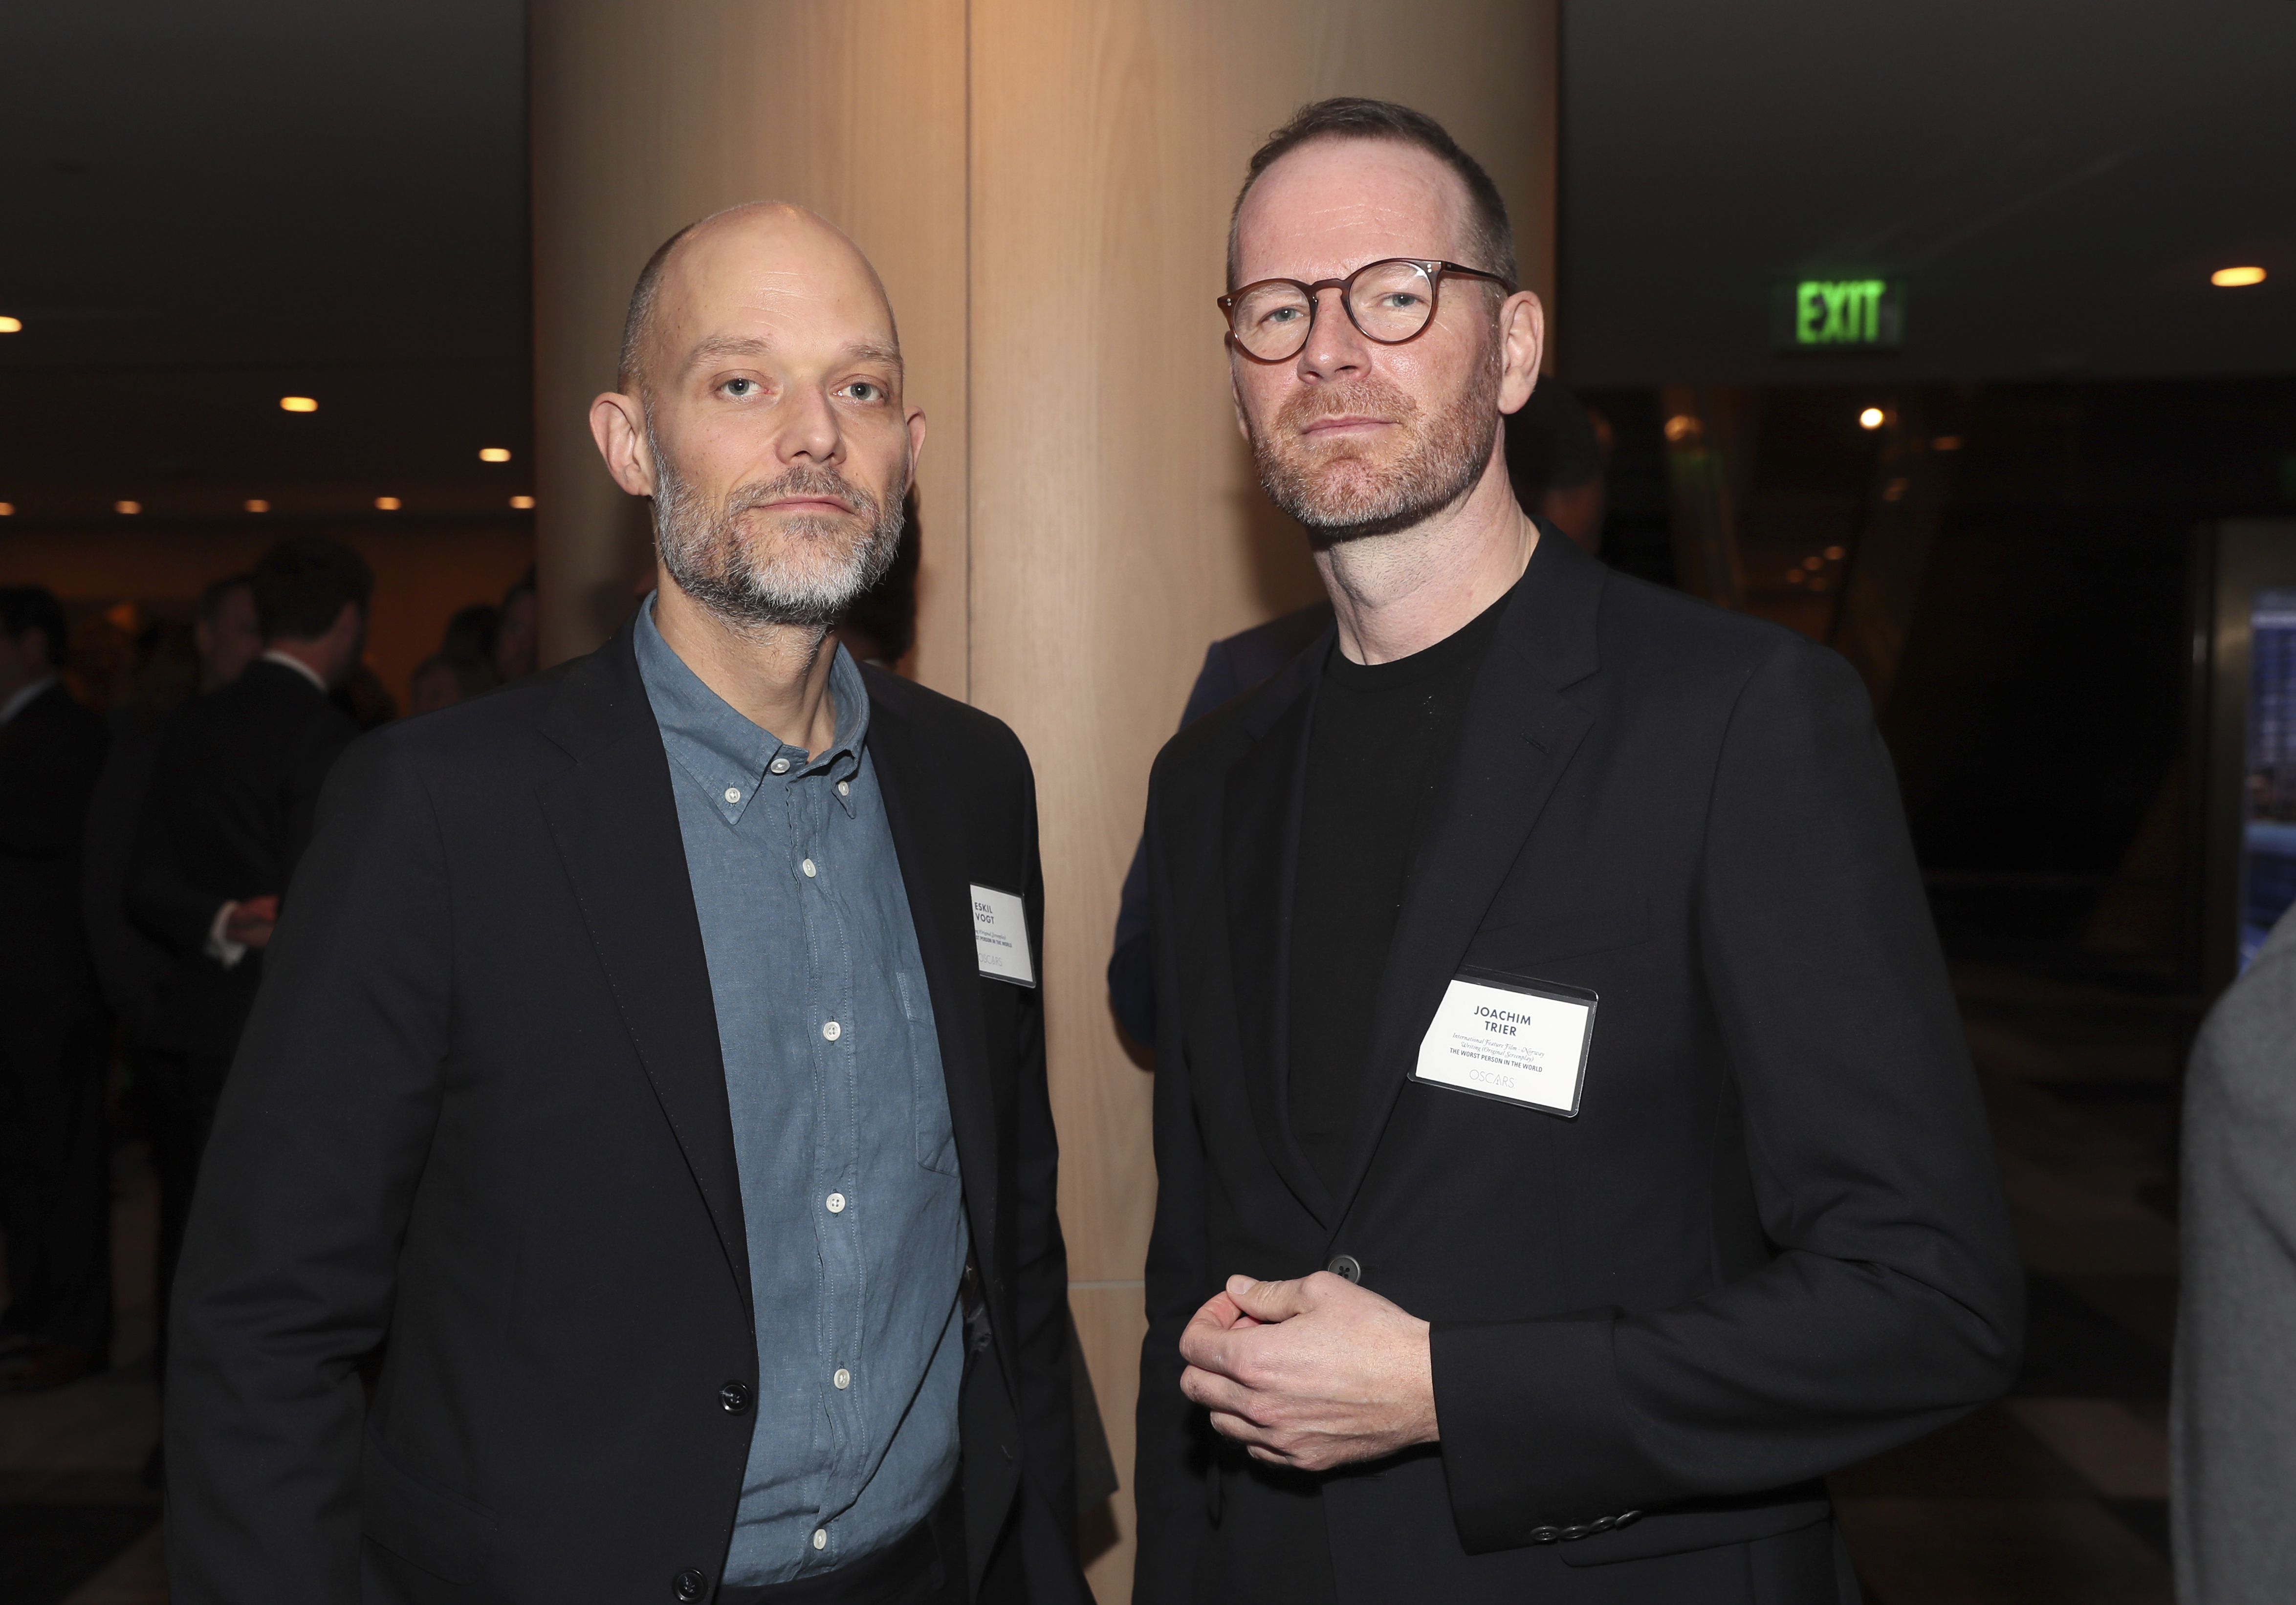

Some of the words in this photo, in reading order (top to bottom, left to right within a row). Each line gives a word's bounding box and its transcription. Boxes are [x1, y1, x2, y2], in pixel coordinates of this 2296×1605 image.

[1796, 280, 1886, 344] EXIT
[975, 902, 993, 913] ESKIL
[975, 912, 994, 924] VOGT
[1474, 1005, 1531, 1025] JOACHIM
[1485, 1020, 1517, 1037] TRIER
[1452, 1033, 1485, 1044] International
[1484, 1039, 1504, 1048] Feature
[1521, 1047, 1545, 1058] Norway
[1461, 1041, 1481, 1052] Writing
[1482, 1046, 1505, 1056] (Original
[1505, 1051, 1534, 1063] Screenplay)
[1461, 1050, 1480, 1059] WORST
[1481, 1055, 1503, 1064] PERSON
[1523, 1063, 1543, 1073] WORLD
[1469, 1069, 1515, 1088] OSCARS
